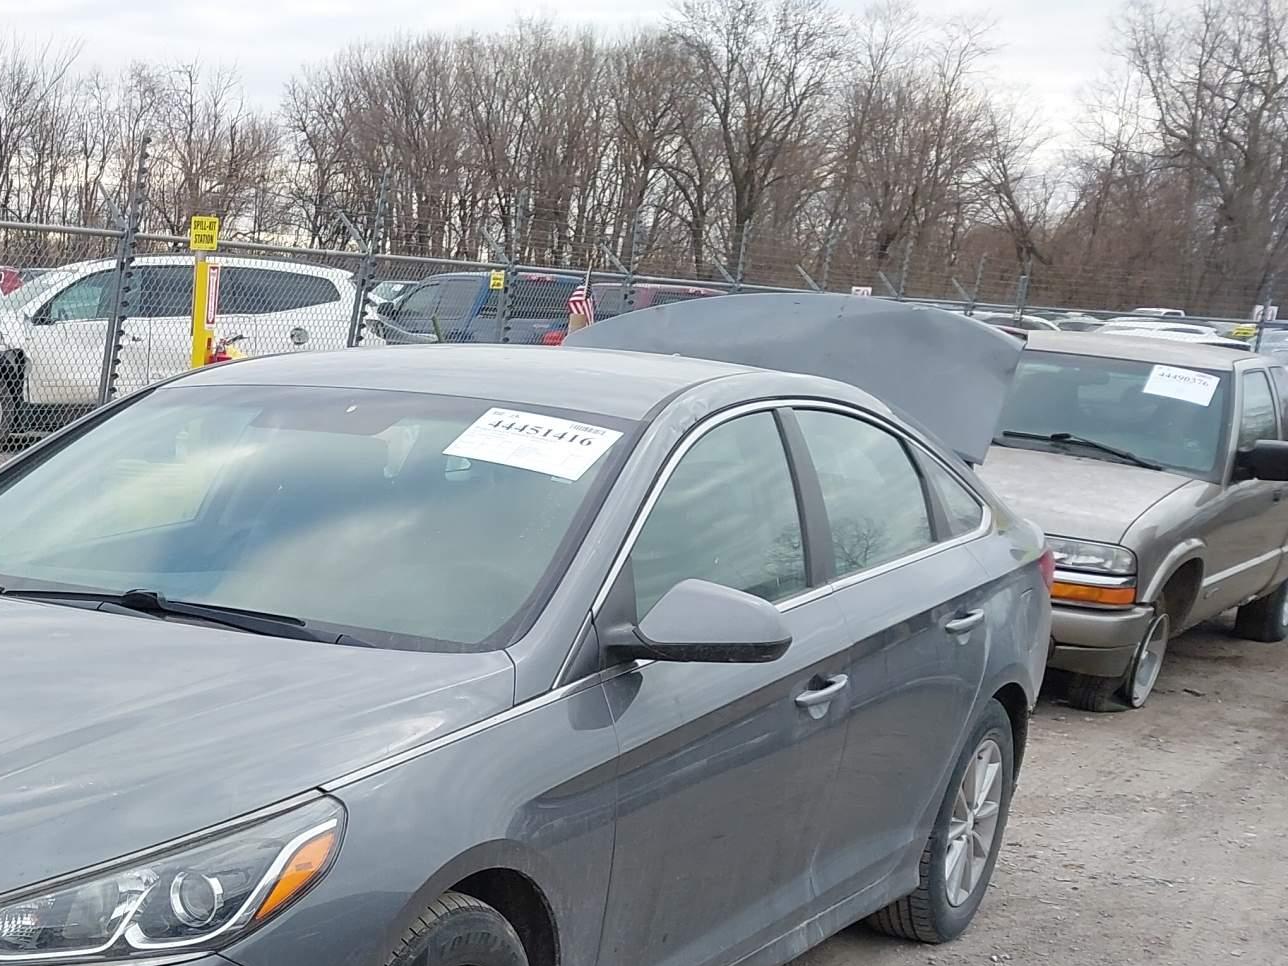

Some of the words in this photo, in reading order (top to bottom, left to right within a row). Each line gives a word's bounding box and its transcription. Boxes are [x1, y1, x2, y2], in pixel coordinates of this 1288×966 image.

[193, 220, 217, 231] SPILL-KIT
[194, 234, 214, 244] STATION
[488, 419, 592, 446] 44451416
